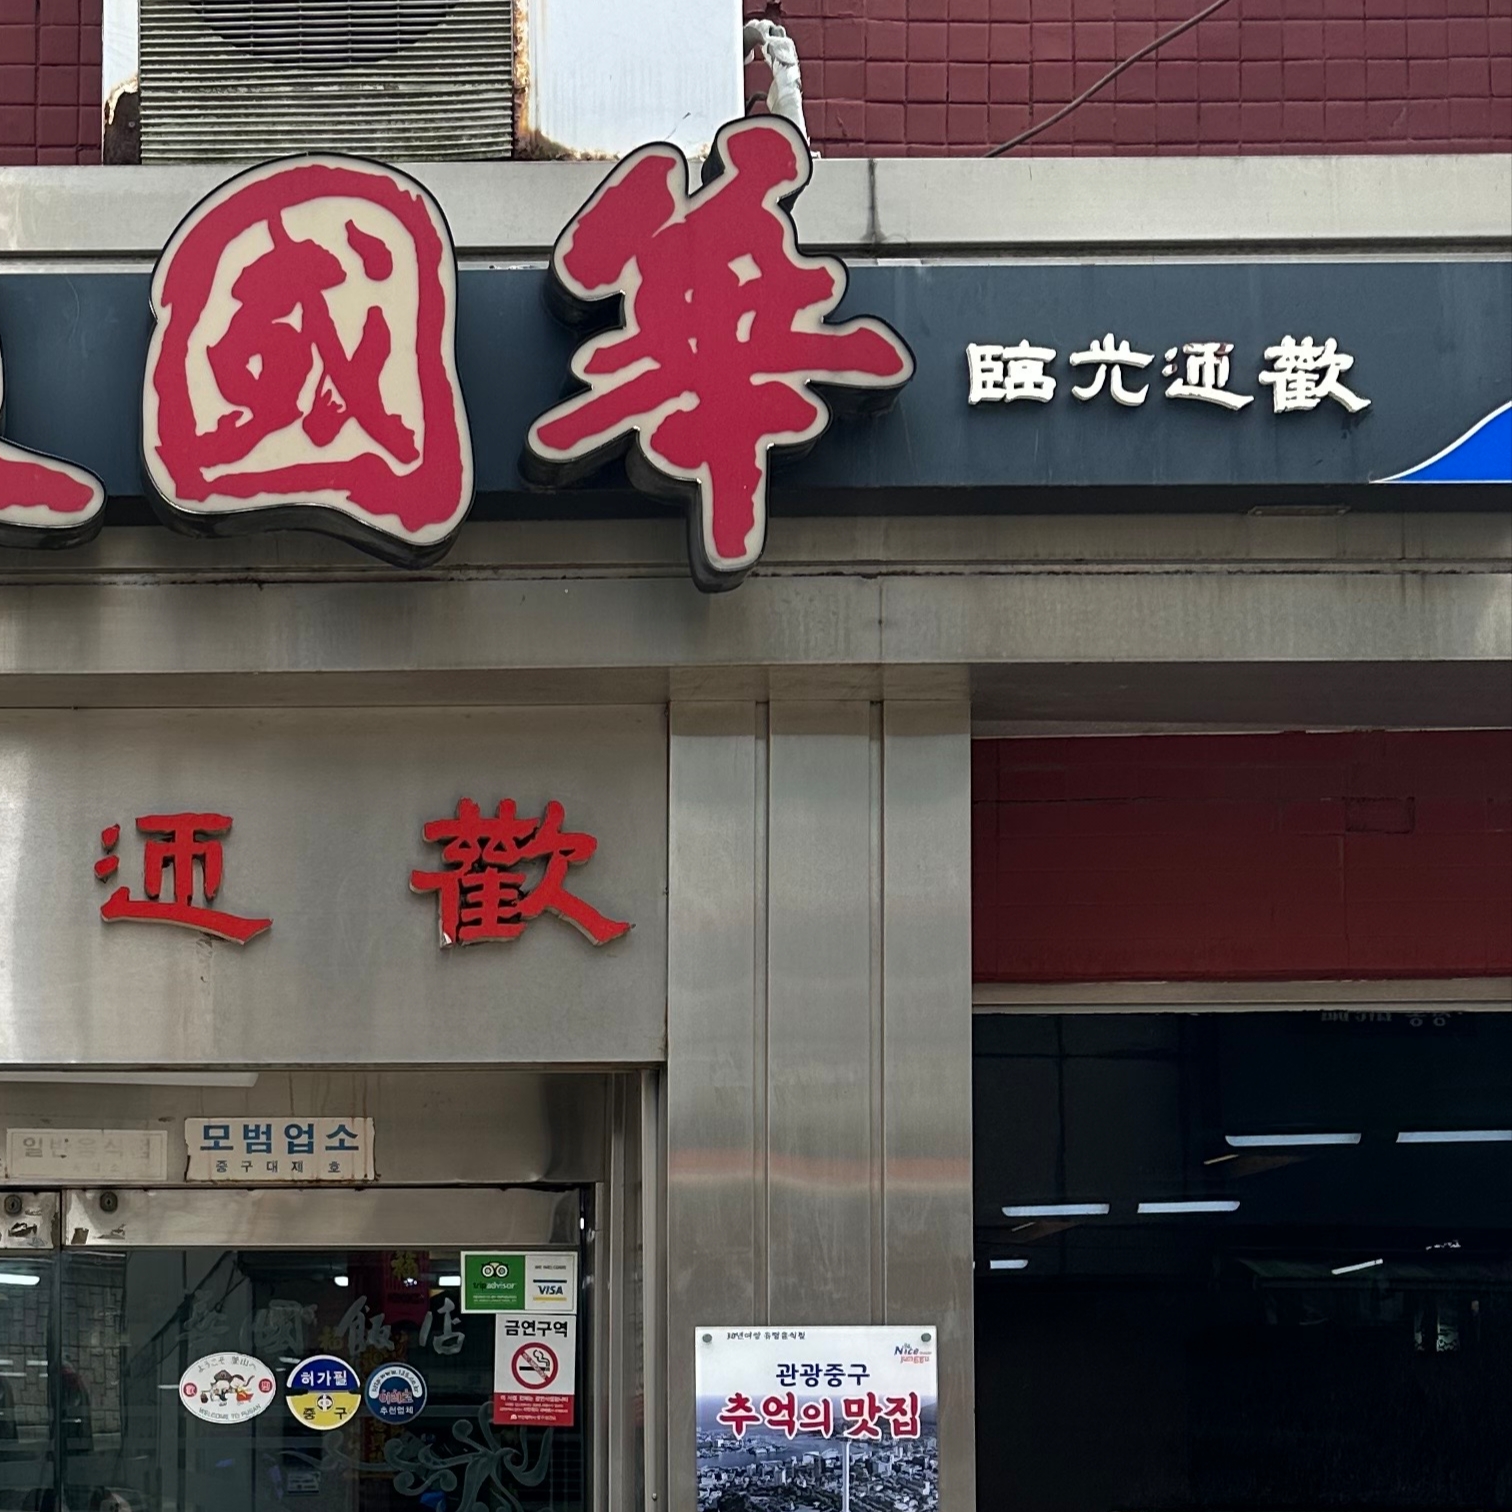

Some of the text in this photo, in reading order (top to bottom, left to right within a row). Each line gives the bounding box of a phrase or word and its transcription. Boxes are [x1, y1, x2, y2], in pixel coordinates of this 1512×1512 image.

[200, 1123, 361, 1155] 모범업소
[473, 1281, 517, 1292] tripadvisor
[538, 1285, 564, 1295] VISA
[504, 1320, 568, 1338] 금연구역
[301, 1370, 347, 1387] 허가필
[775, 1363, 870, 1387] 관광중구
[198, 1407, 229, 1420] WELCOME
[379, 1405, 414, 1416] 추천업체
[718, 1391, 921, 1438] 추억의 맛집
